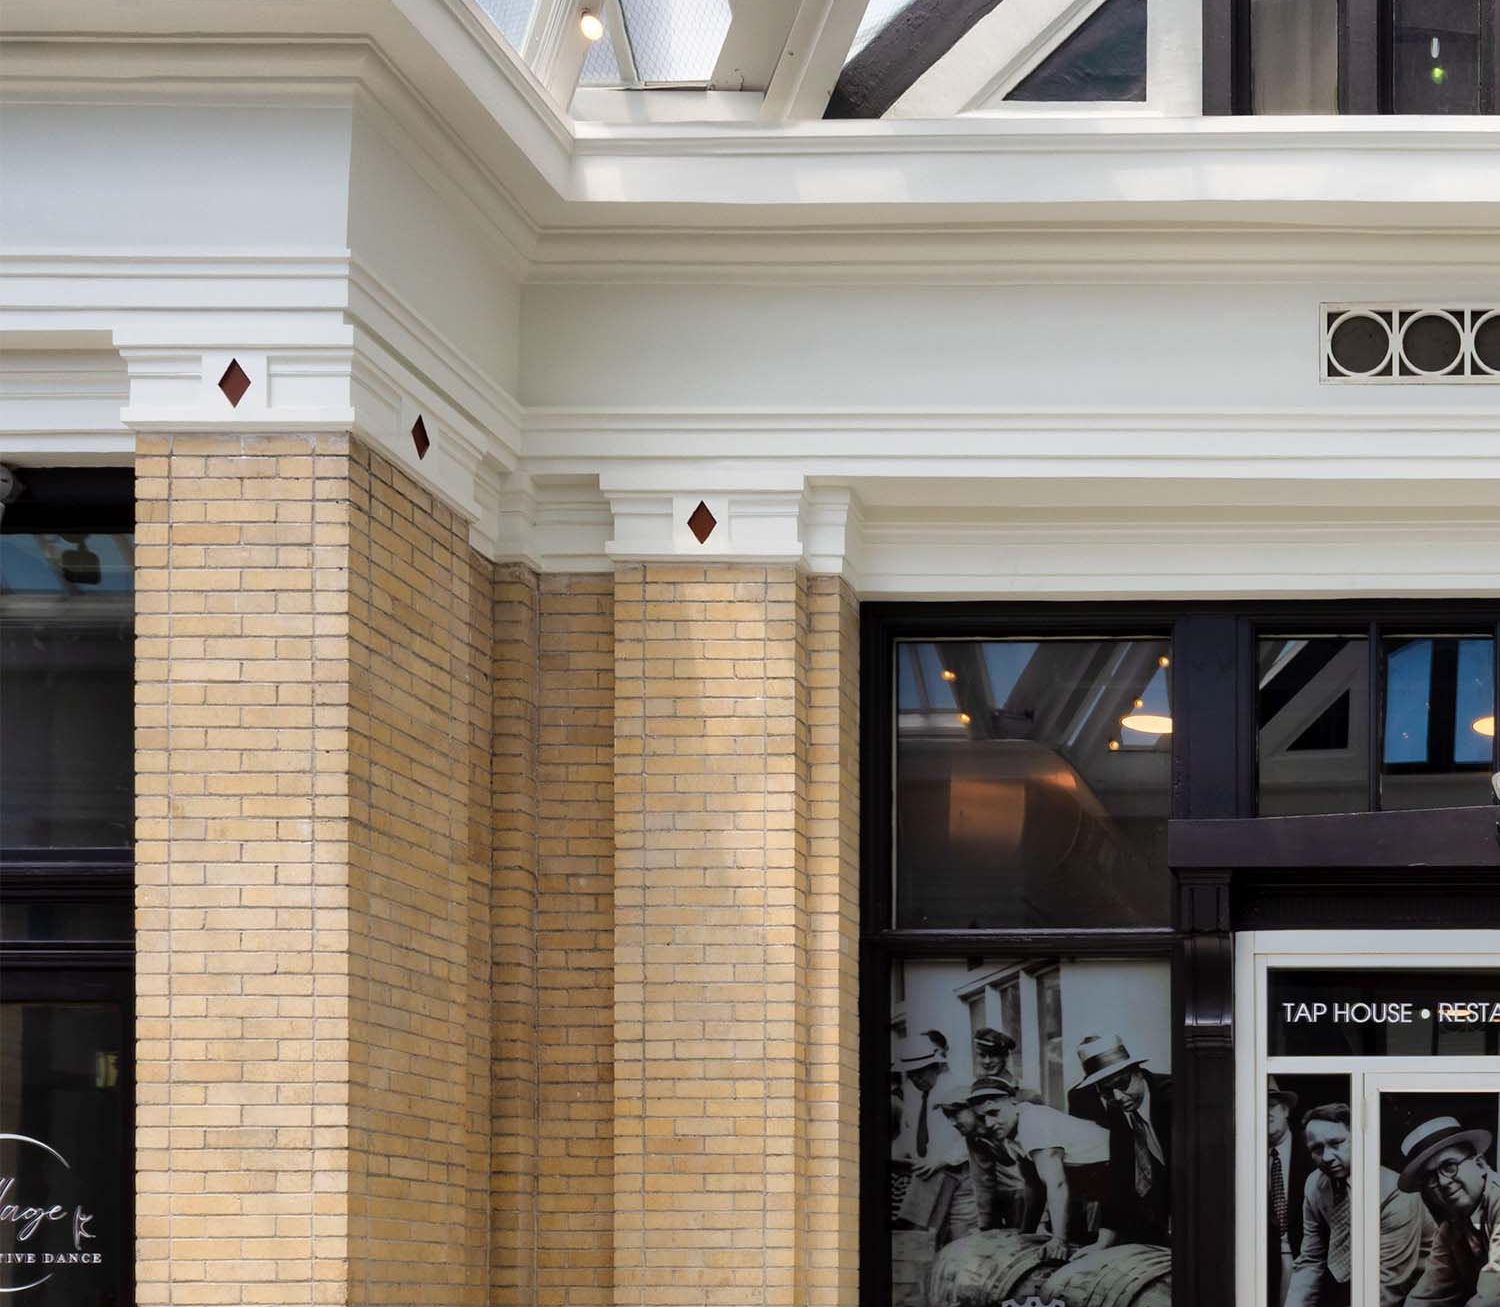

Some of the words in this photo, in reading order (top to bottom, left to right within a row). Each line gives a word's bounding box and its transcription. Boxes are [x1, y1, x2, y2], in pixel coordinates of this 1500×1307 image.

[1282, 1002, 1328, 1024] TAP
[1333, 1002, 1413, 1024] HOUSE
[43, 1252, 103, 1264] DANCE
